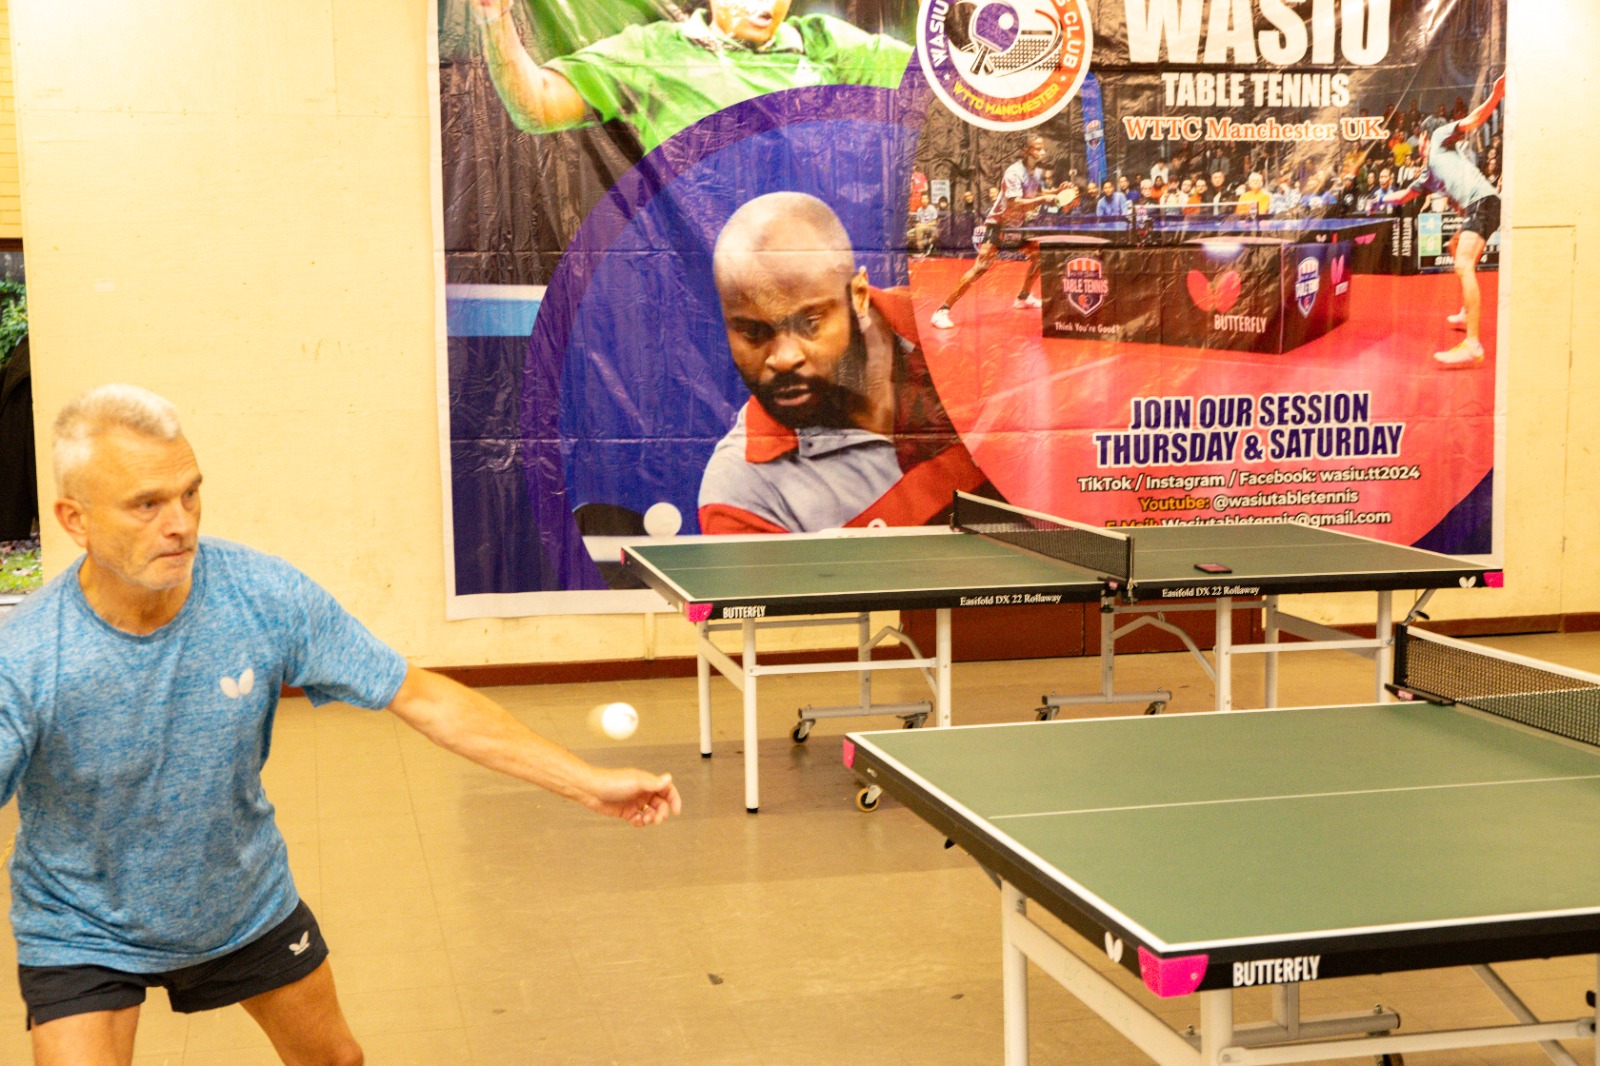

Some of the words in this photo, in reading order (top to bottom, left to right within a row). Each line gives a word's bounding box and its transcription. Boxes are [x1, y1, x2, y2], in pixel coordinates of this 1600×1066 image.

[929, 0, 949, 67] WASIU
[1063, 11, 1082, 68] CLUB
[1125, 0, 1391, 65] WASIU
[985, 83, 1060, 115] MANCHESTER
[1162, 73, 1245, 107] TABLE
[1251, 72, 1350, 107] TENNIS
[1123, 116, 1202, 141] WTTC
[1205, 117, 1336, 142] Manchester
[1340, 116, 1390, 140] UK.
[1055, 321, 1074, 331] Think
[1075, 323, 1096, 332] You're
[1214, 315, 1267, 333] BUTTERFLY
[1131, 399, 1191, 430] JOIN
[1200, 397, 1251, 428] OUR
[1259, 393, 1370, 426] SESSION
[1095, 431, 1239, 465] THURSDAY
[1244, 434, 1263, 460] &
[1271, 425, 1403, 459] SATURDAY
[1078, 475, 1132, 491] TikTok
[1146, 474, 1225, 491] Instagram
[1239, 468, 1316, 486] Facebook:
[1320, 465, 1421, 483] wasiu.tt2024
[1139, 495, 1210, 511] Youtube:
[1213, 488, 1359, 512] @wasiutabletennis
[960, 595, 994, 606] Easifold
[995, 595, 1010, 605] DX
[1011, 594, 1022, 604] 22
[1023, 593, 1062, 604] Rollaway
[1162, 587, 1194, 598] Easifold
[1195, 586, 1210, 596] DX
[1211, 586, 1222, 596] 22
[1223, 585, 1260, 596] Rollaway
[722, 605, 766, 619] BUTTERFLY
[1232, 955, 1321, 987] BUTTERFLY
